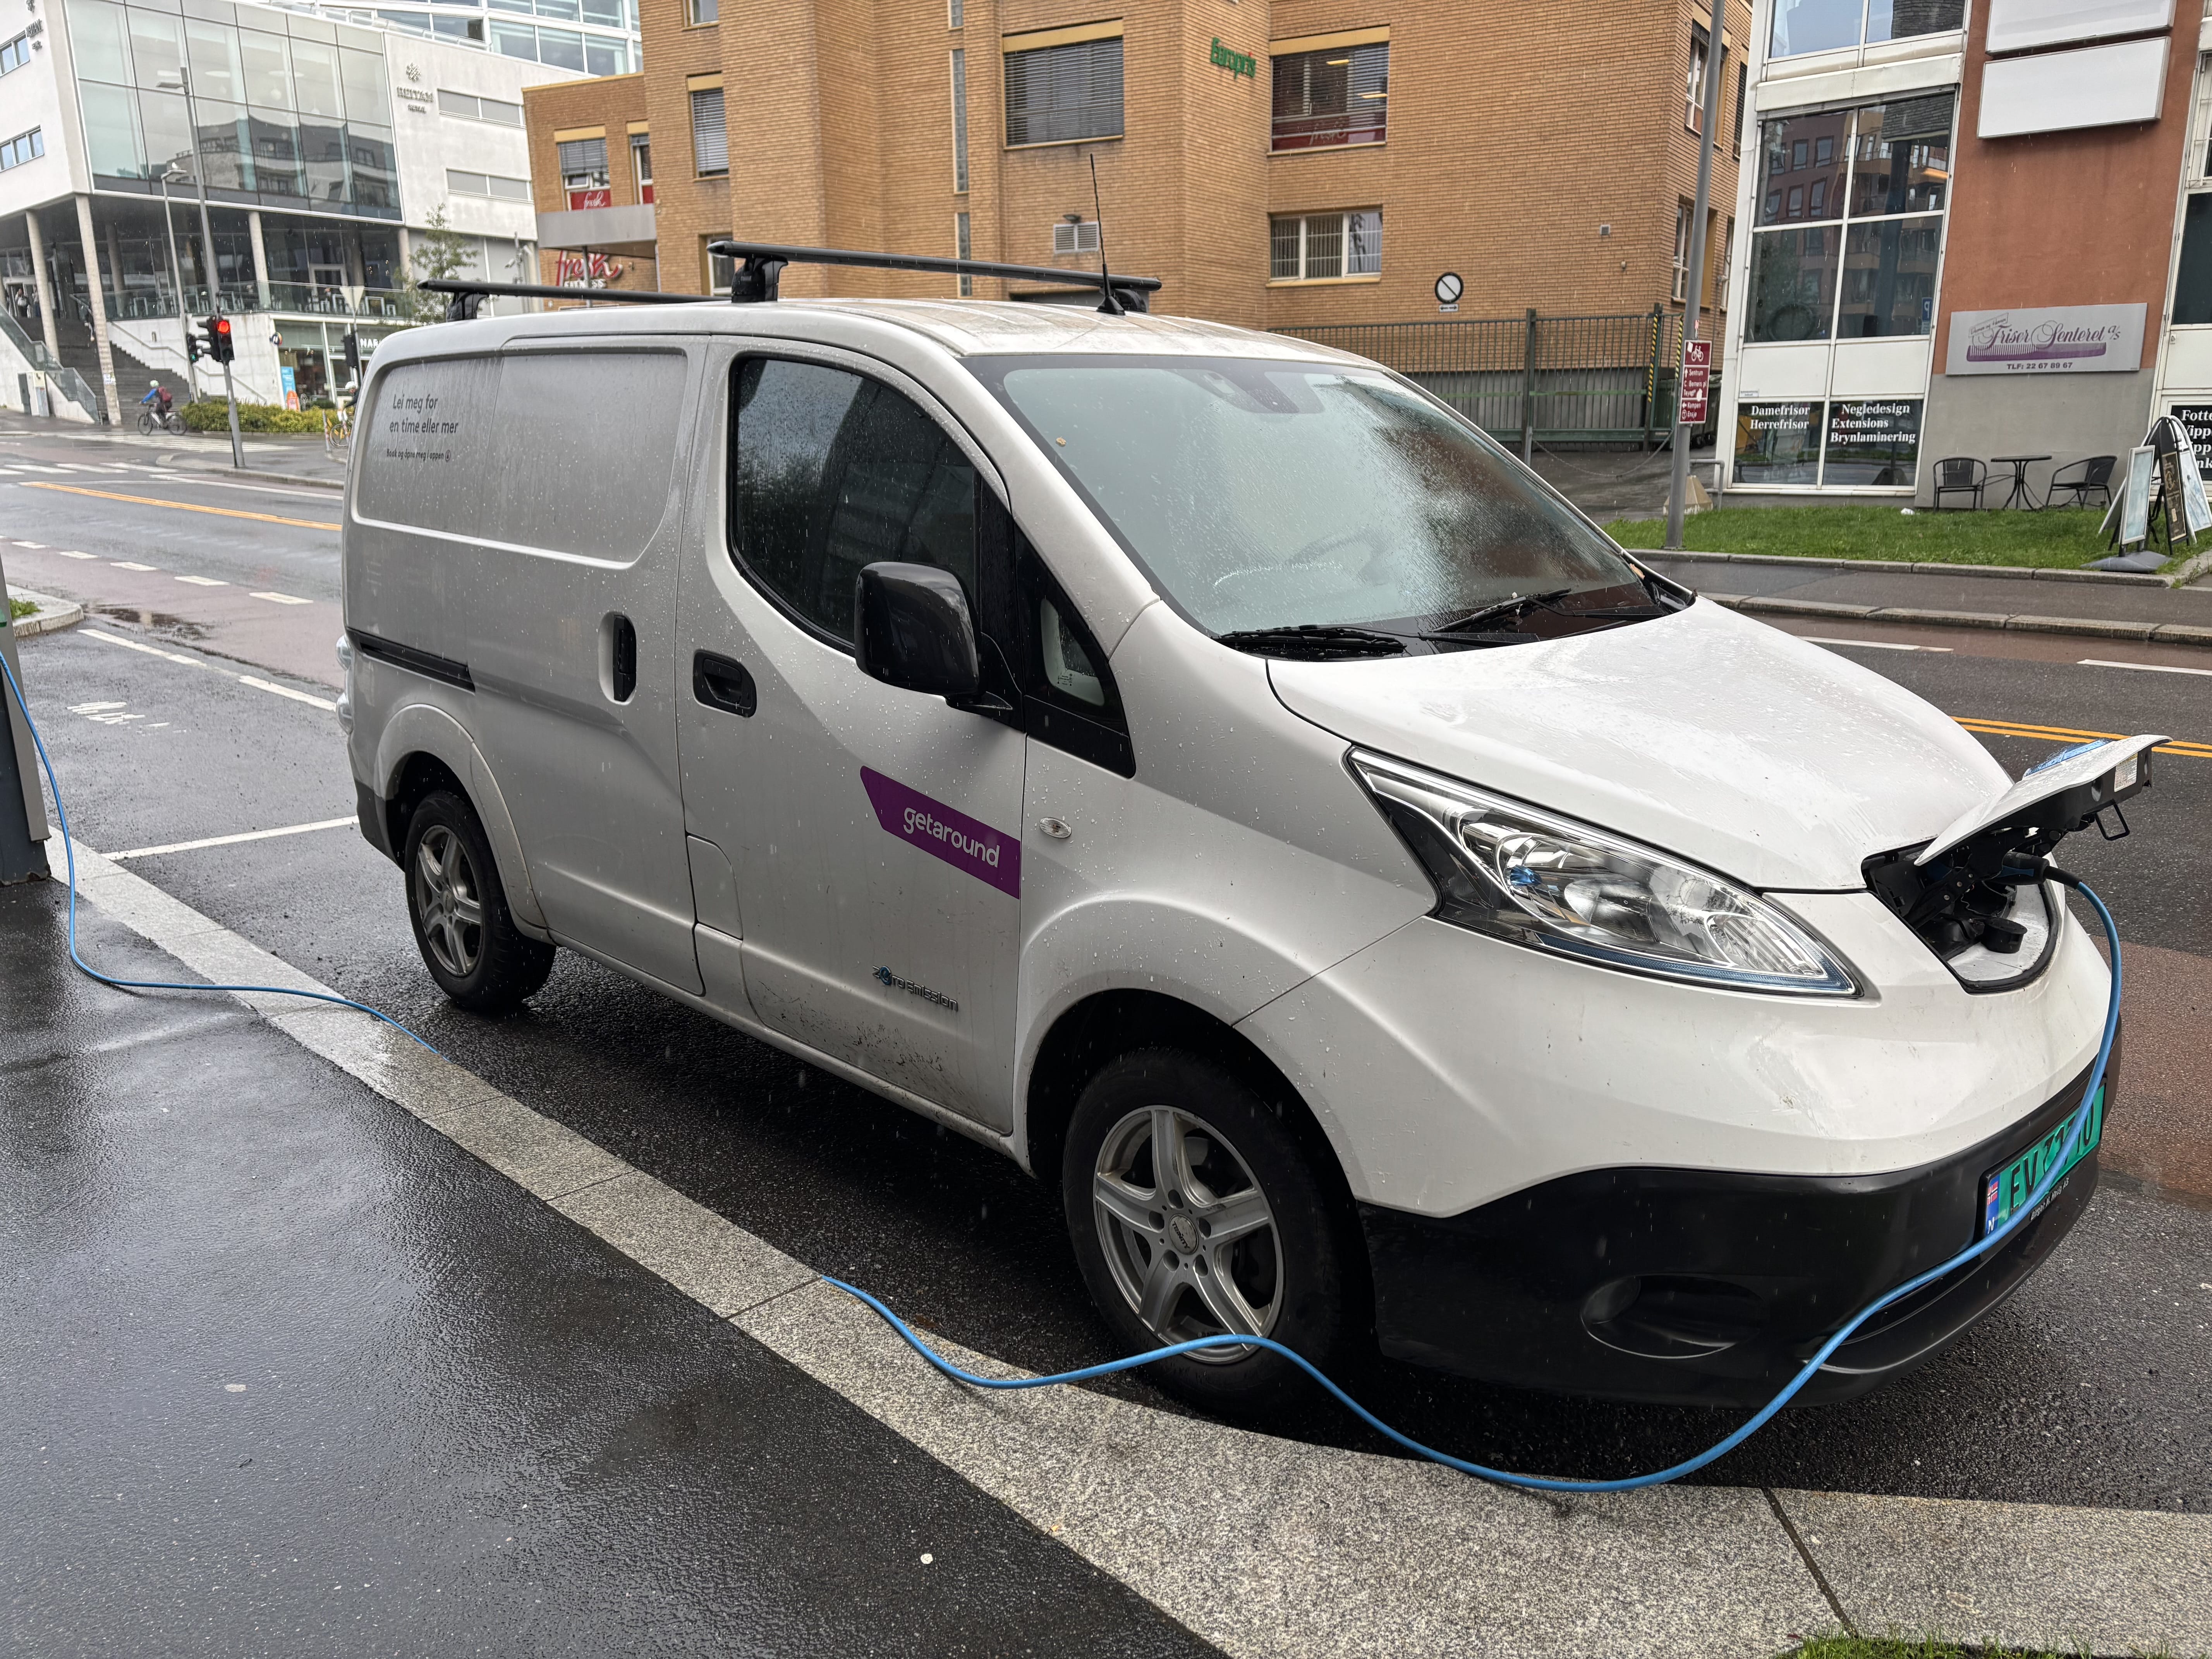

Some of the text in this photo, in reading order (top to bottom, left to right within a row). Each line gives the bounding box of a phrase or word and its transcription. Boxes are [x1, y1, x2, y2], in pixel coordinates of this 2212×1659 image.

[1211, 37, 1256, 80] Europris
[397, 86, 433, 102] REITAN
[2031, 319, 2106, 349] Senteret
[393, 393, 438, 414] Lei meg for
[1841, 403, 1910, 417] Negledesign
[390, 417, 458, 433] en time eller mer
[1832, 417, 1889, 429] Extensions
[1830, 431, 1916, 445] Brynlaminering
[416, 452, 426, 462] meg
[429, 452, 444, 461] appen
[903, 807, 1000, 868] getaround
[906, 979, 958, 1012] Emission
